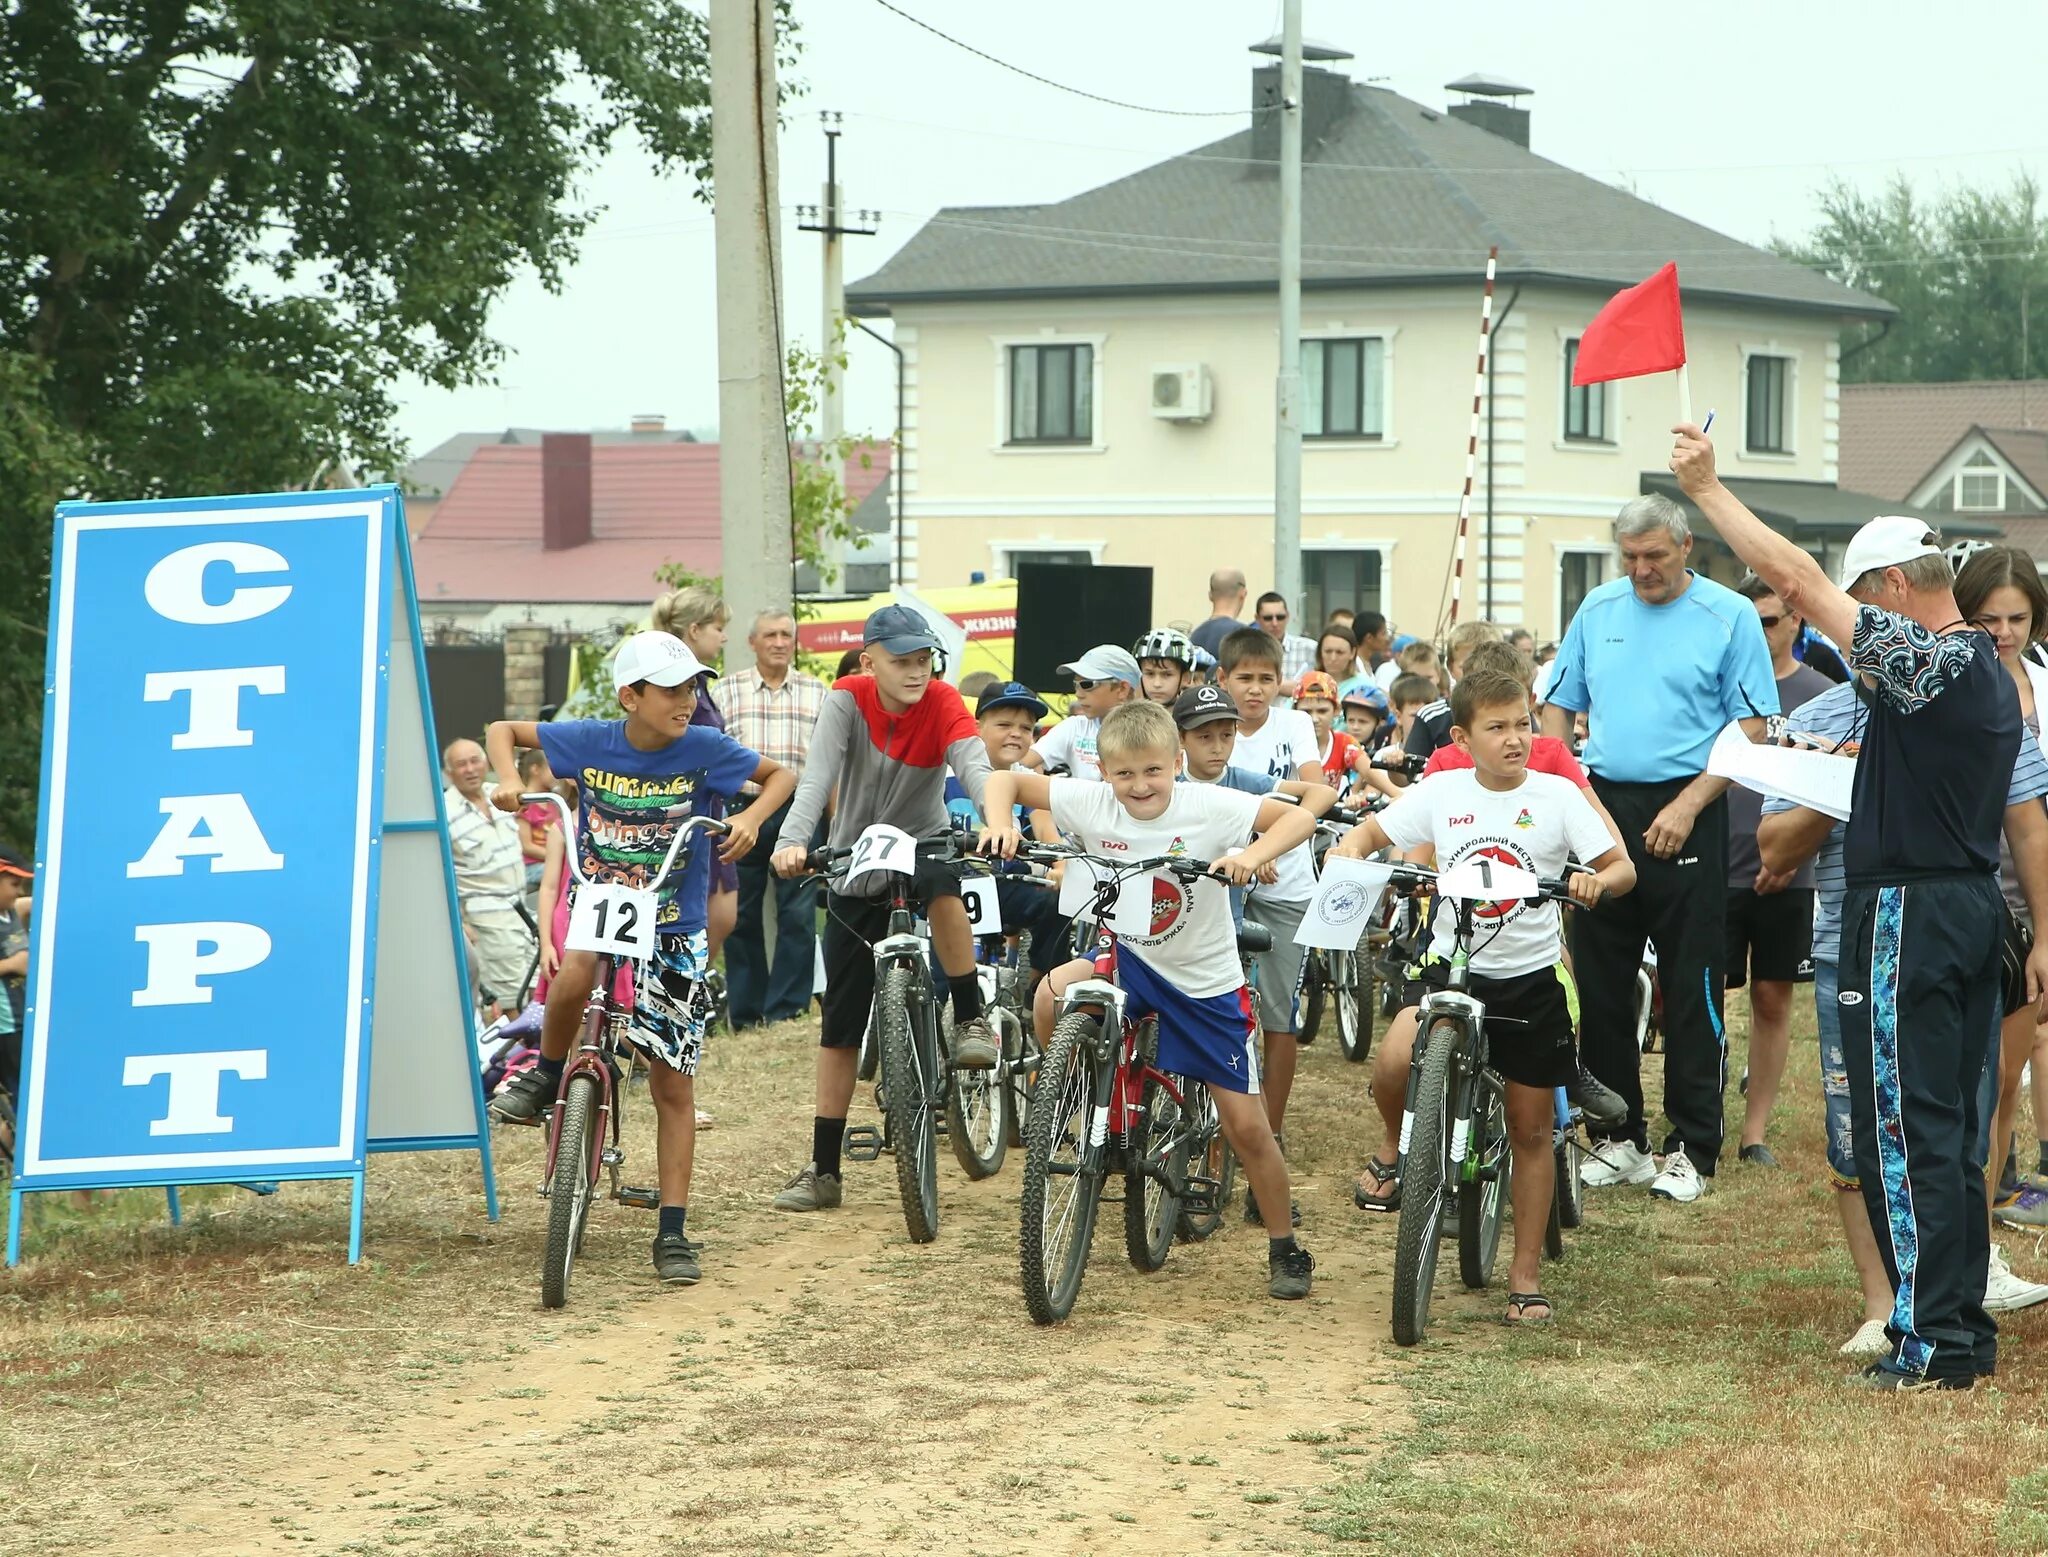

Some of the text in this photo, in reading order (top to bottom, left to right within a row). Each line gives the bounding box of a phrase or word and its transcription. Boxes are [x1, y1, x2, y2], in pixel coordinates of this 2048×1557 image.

[122, 541, 293, 1137] СТАРТ
[588, 805, 675, 844] brings
[853, 834, 899, 870] 27
[1446, 836, 1536, 874] ДУНАРОДНЫЙ ФЕСТИВ
[1472, 860, 1492, 889] 1
[962, 891, 982, 924] 9
[1091, 880, 1116, 921] 2
[1182, 883, 1194, 913] ИВАЛЬ
[592, 898, 639, 945] 12
